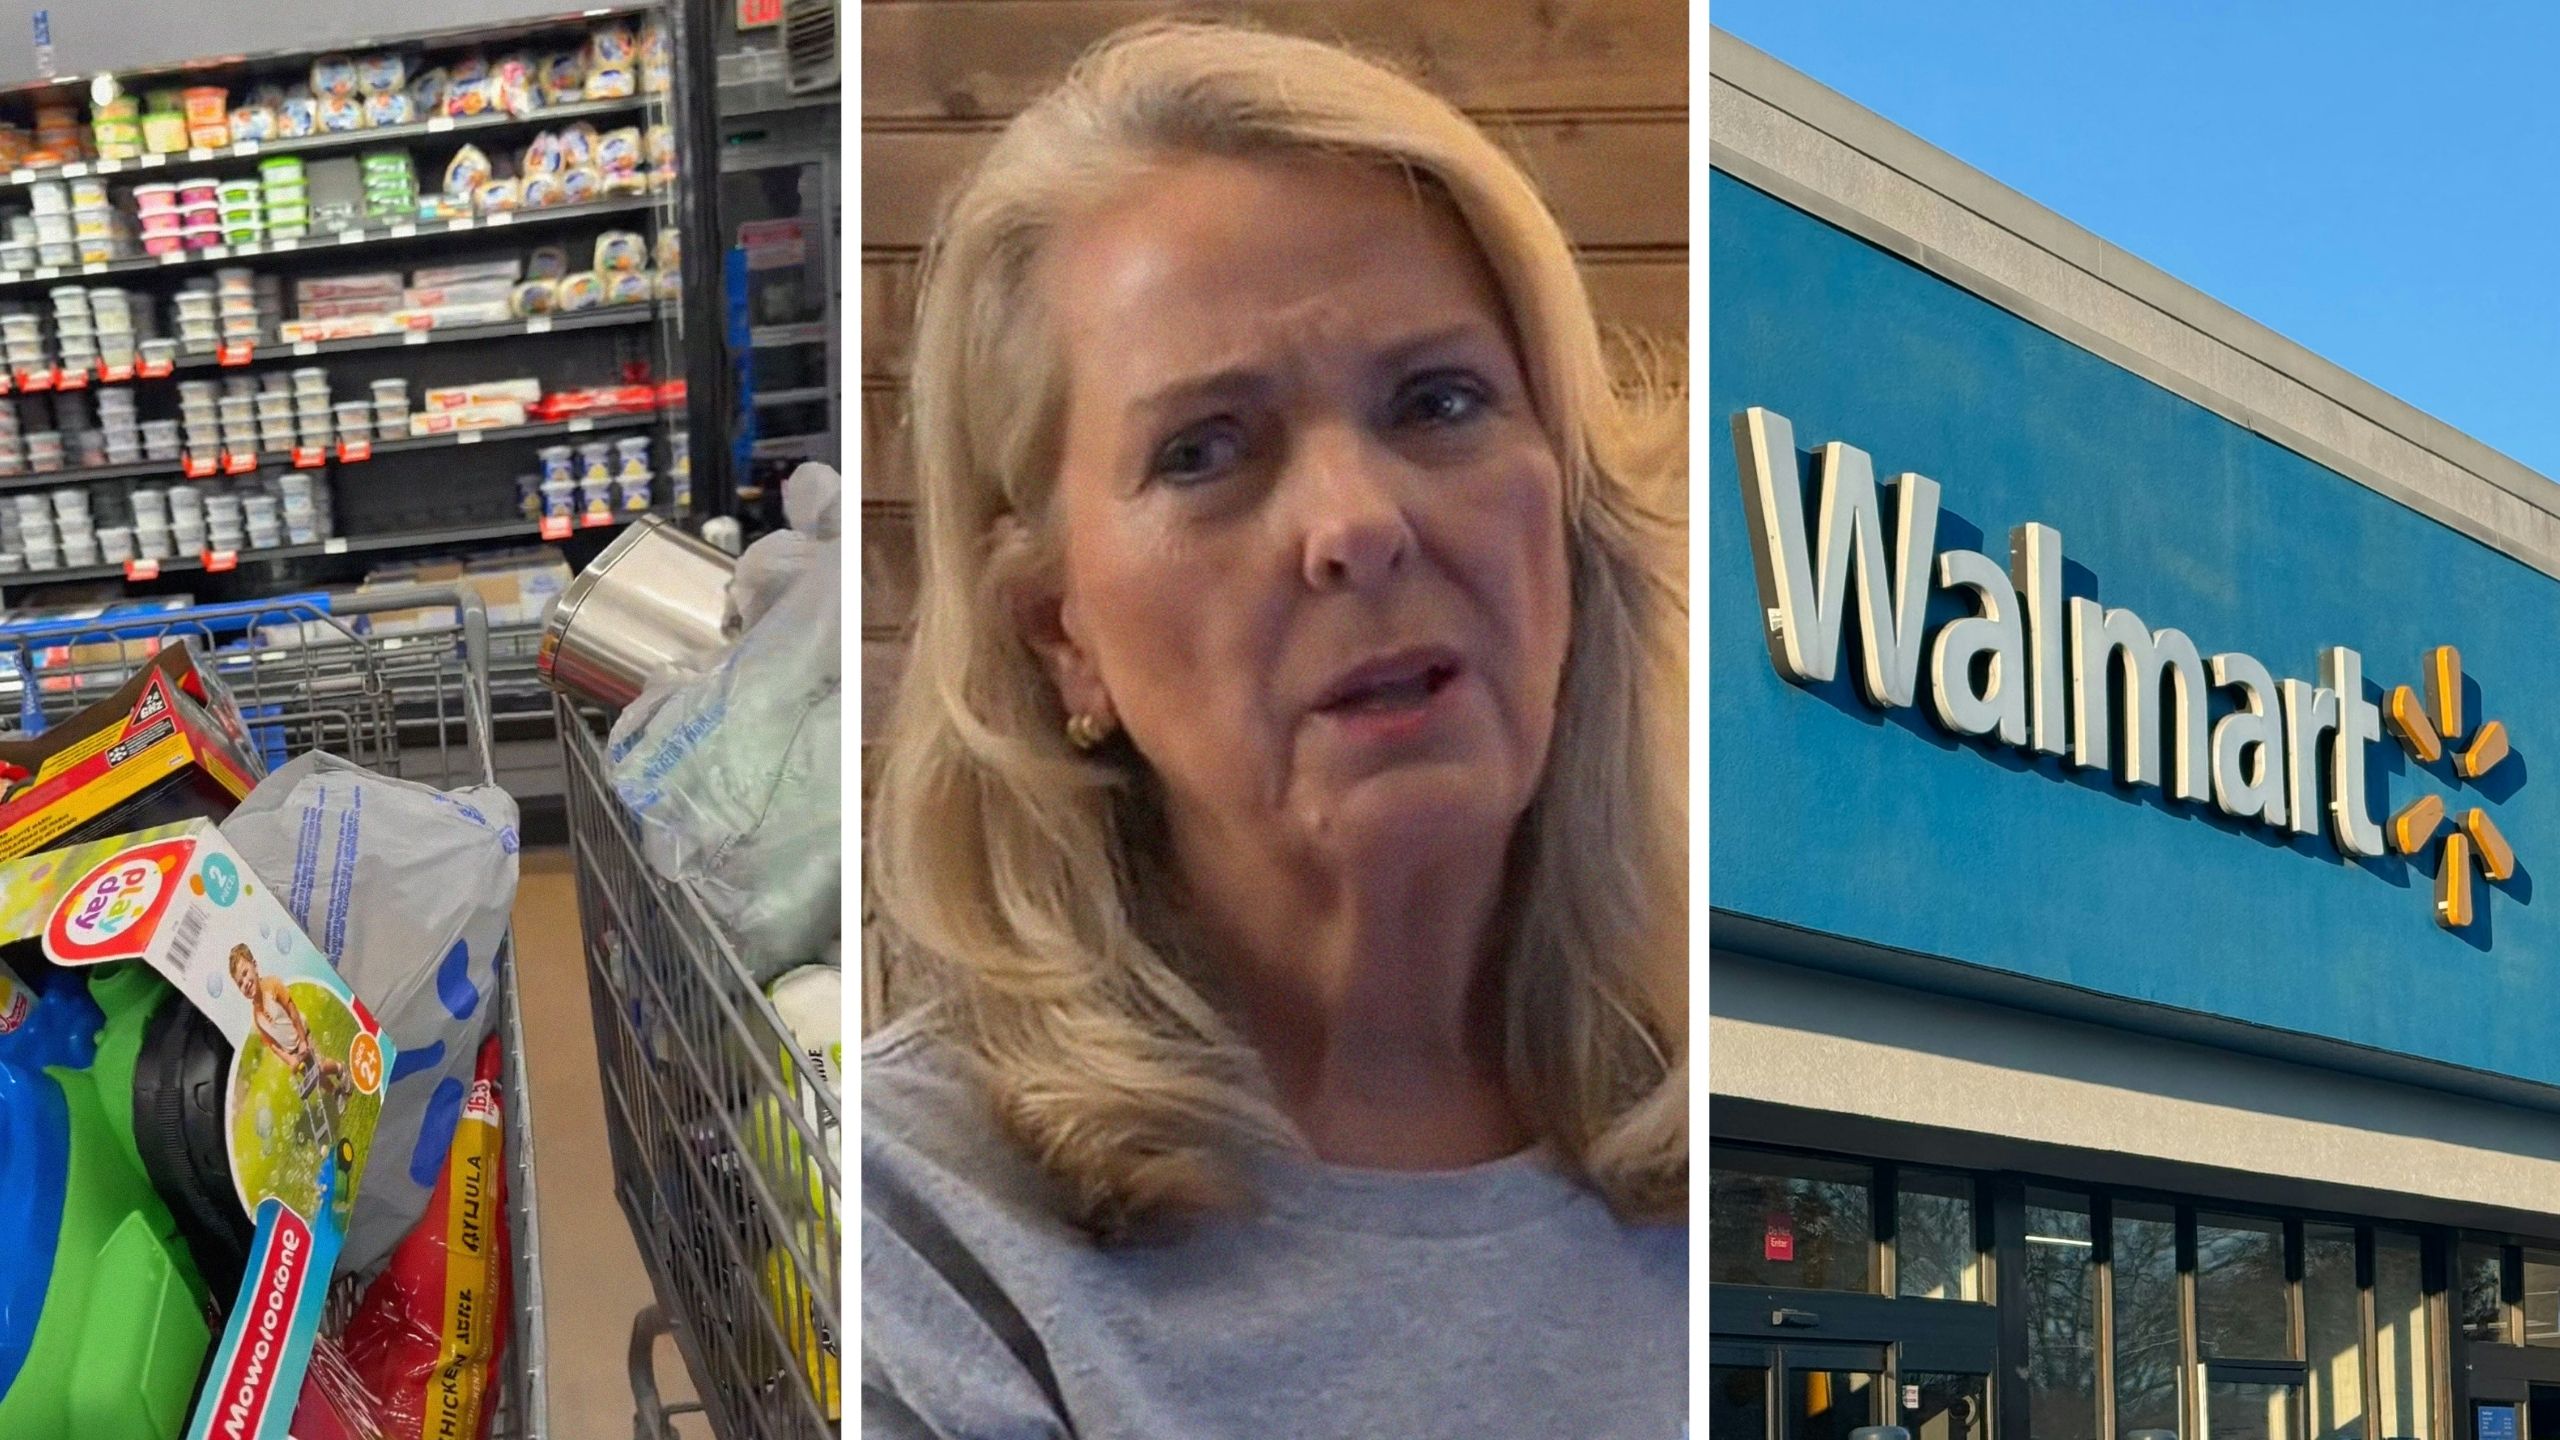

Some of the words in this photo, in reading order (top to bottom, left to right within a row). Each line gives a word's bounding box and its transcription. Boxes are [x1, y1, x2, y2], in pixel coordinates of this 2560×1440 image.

[1733, 407, 2385, 858] Walmart
[74, 875, 121, 931] day
[98, 866, 147, 934] play
[208, 865, 227, 888] 2
[438, 1354, 468, 1440] HICKEN
